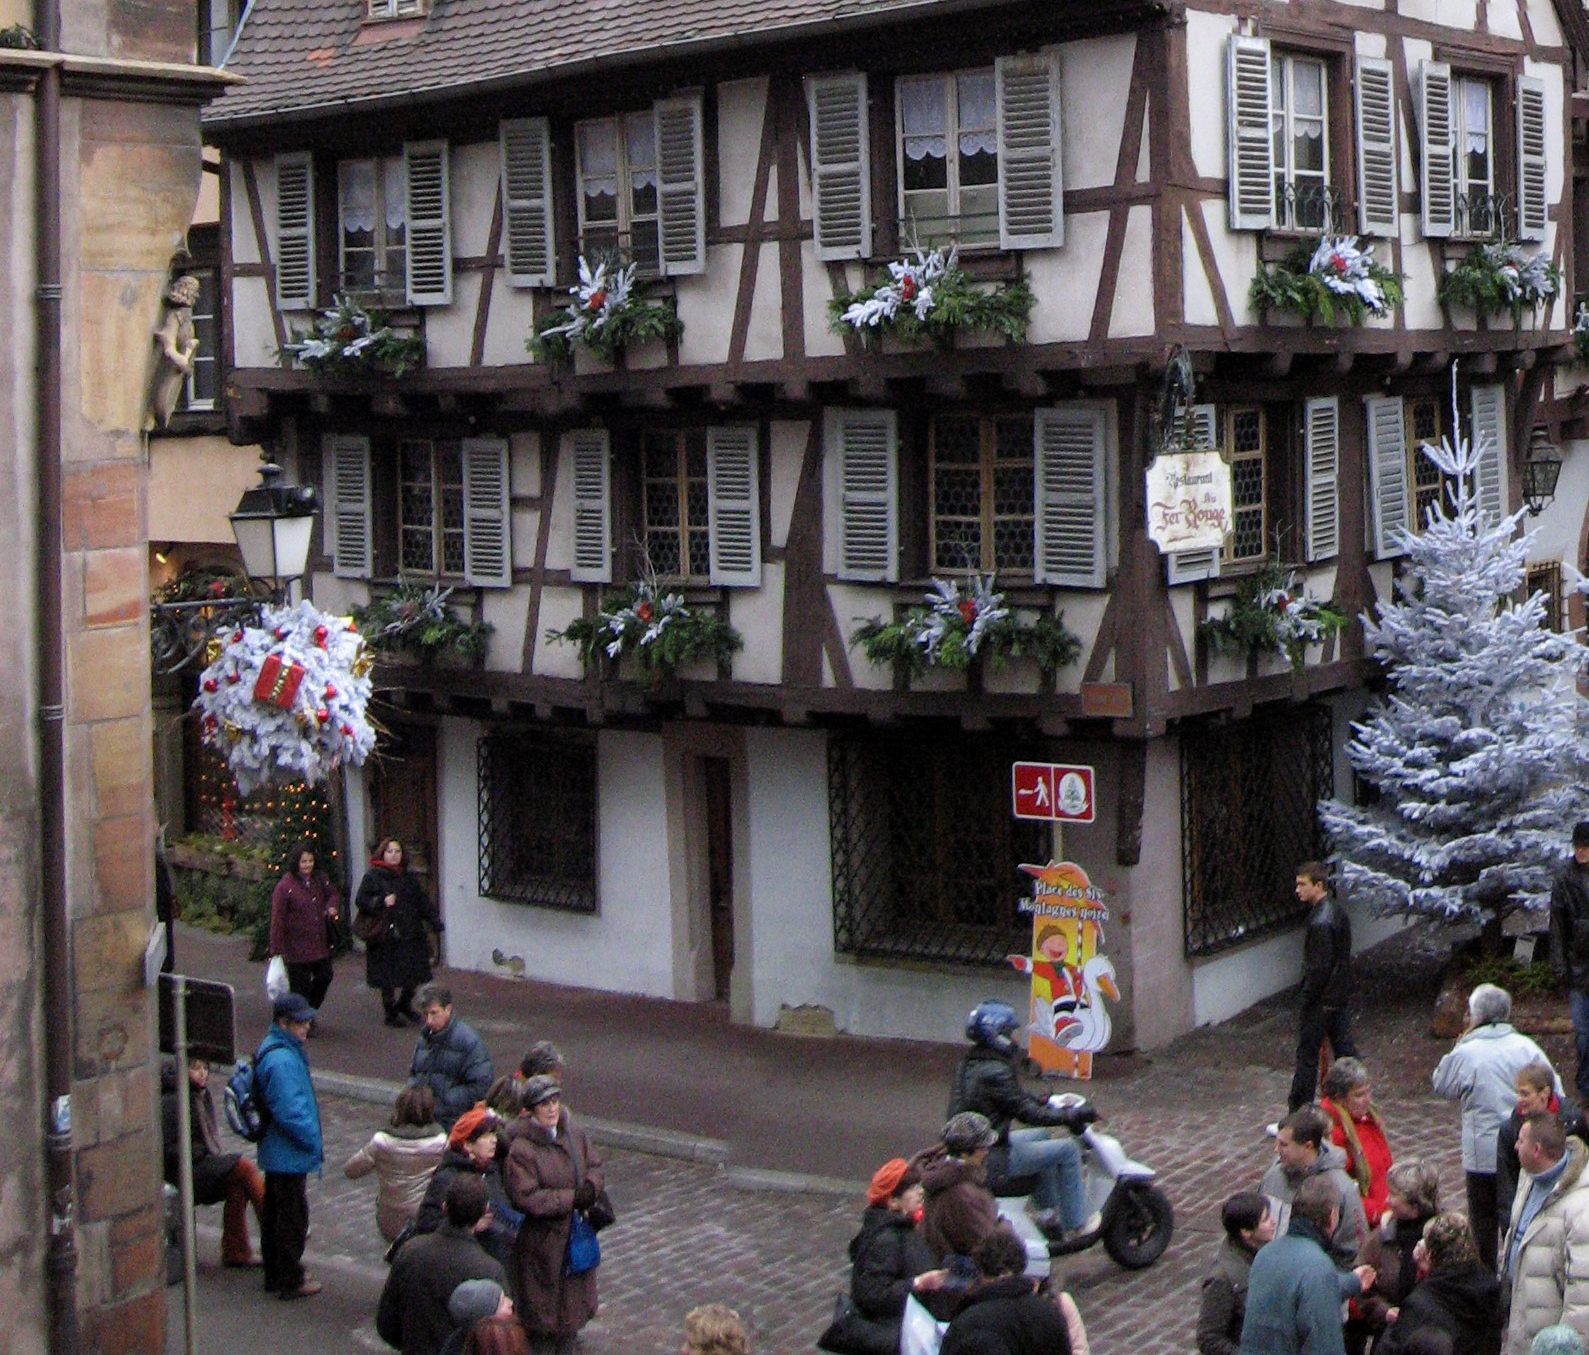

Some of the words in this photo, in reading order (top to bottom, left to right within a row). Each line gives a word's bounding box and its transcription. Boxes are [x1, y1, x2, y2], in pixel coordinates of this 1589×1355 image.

[1151, 501, 1182, 533] Fer
[1181, 497, 1228, 536] Rouge
[1034, 878, 1062, 896] Place
[1065, 884, 1083, 900] des
[1018, 897, 1077, 919] Montagnes
